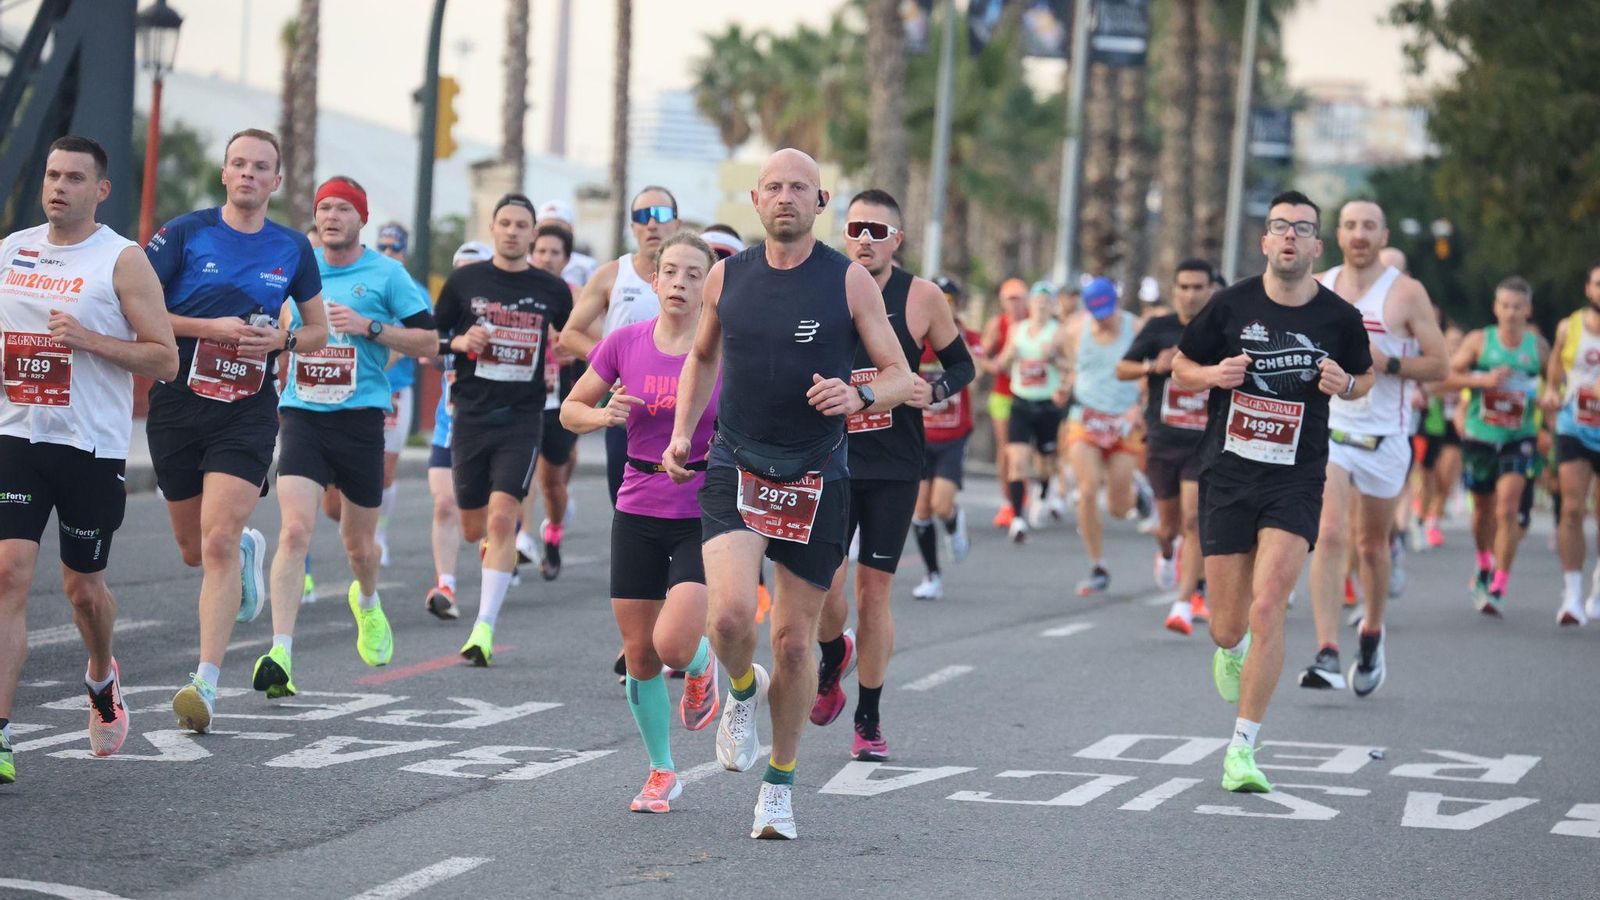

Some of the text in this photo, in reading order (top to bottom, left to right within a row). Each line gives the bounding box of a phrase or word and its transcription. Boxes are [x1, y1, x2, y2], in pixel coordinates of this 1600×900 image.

[5, 269, 84, 294] Run2Forty2
[259, 271, 288, 283] SWISSMAN
[17, 335, 67, 348] GENER
[491, 345, 526, 359] 12621
[16, 357, 51, 373] 1789
[215, 358, 247, 376] 1988
[1255, 354, 1312, 370] CHEERS
[303, 365, 341, 378] 12724
[1249, 399, 1298, 416] GENERALI
[1242, 416, 1285, 435] 14997
[758, 486, 798, 507] 2973
[1072, 733, 1543, 785] RED
[817, 760, 1600, 839] ASICA
